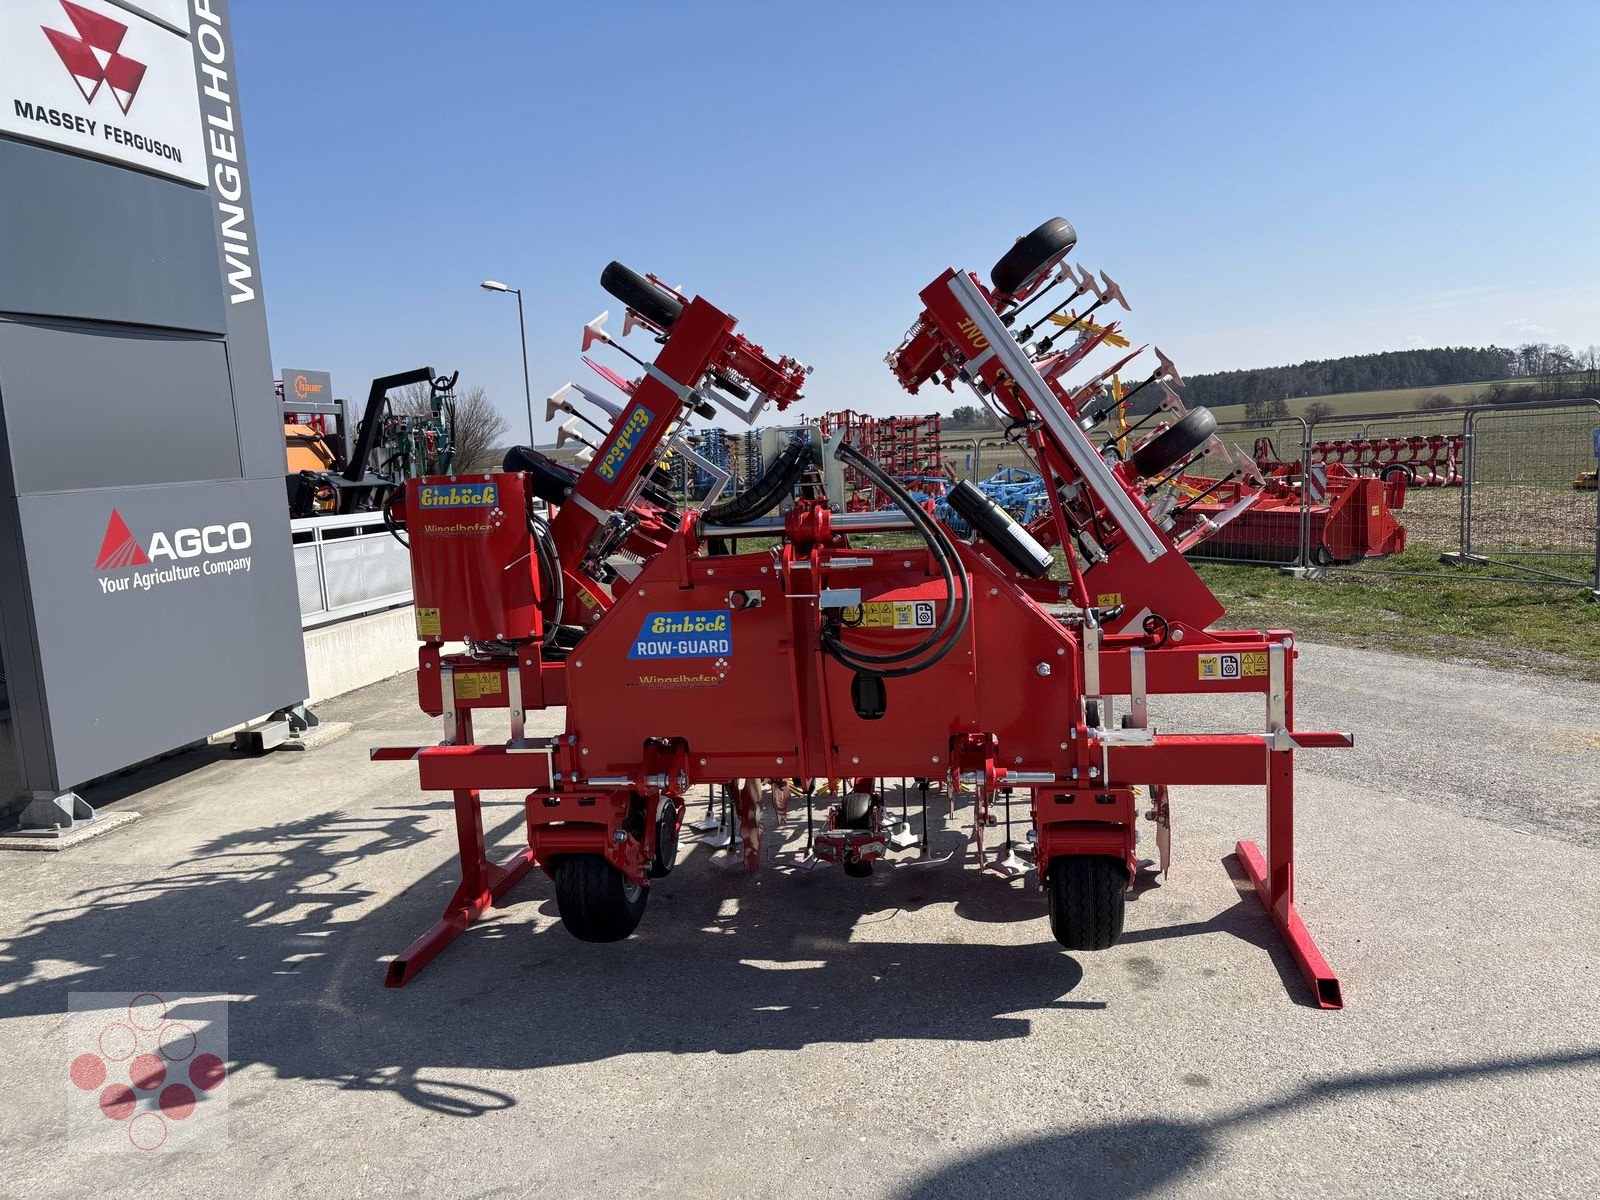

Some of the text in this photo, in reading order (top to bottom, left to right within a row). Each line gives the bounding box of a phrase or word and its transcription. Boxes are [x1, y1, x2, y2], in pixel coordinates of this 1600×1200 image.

[14, 99, 183, 163] MASSEY FERGUSON
[194, 0, 255, 304] WINGELHOF
[599, 408, 649, 479] Einböck
[421, 486, 495, 506] Einböck
[148, 521, 252, 563] AGCO
[99, 556, 251, 594] Your Agriculture Company
[651, 615, 726, 634] Einböck
[637, 639, 729, 656] ROW-GUARD
